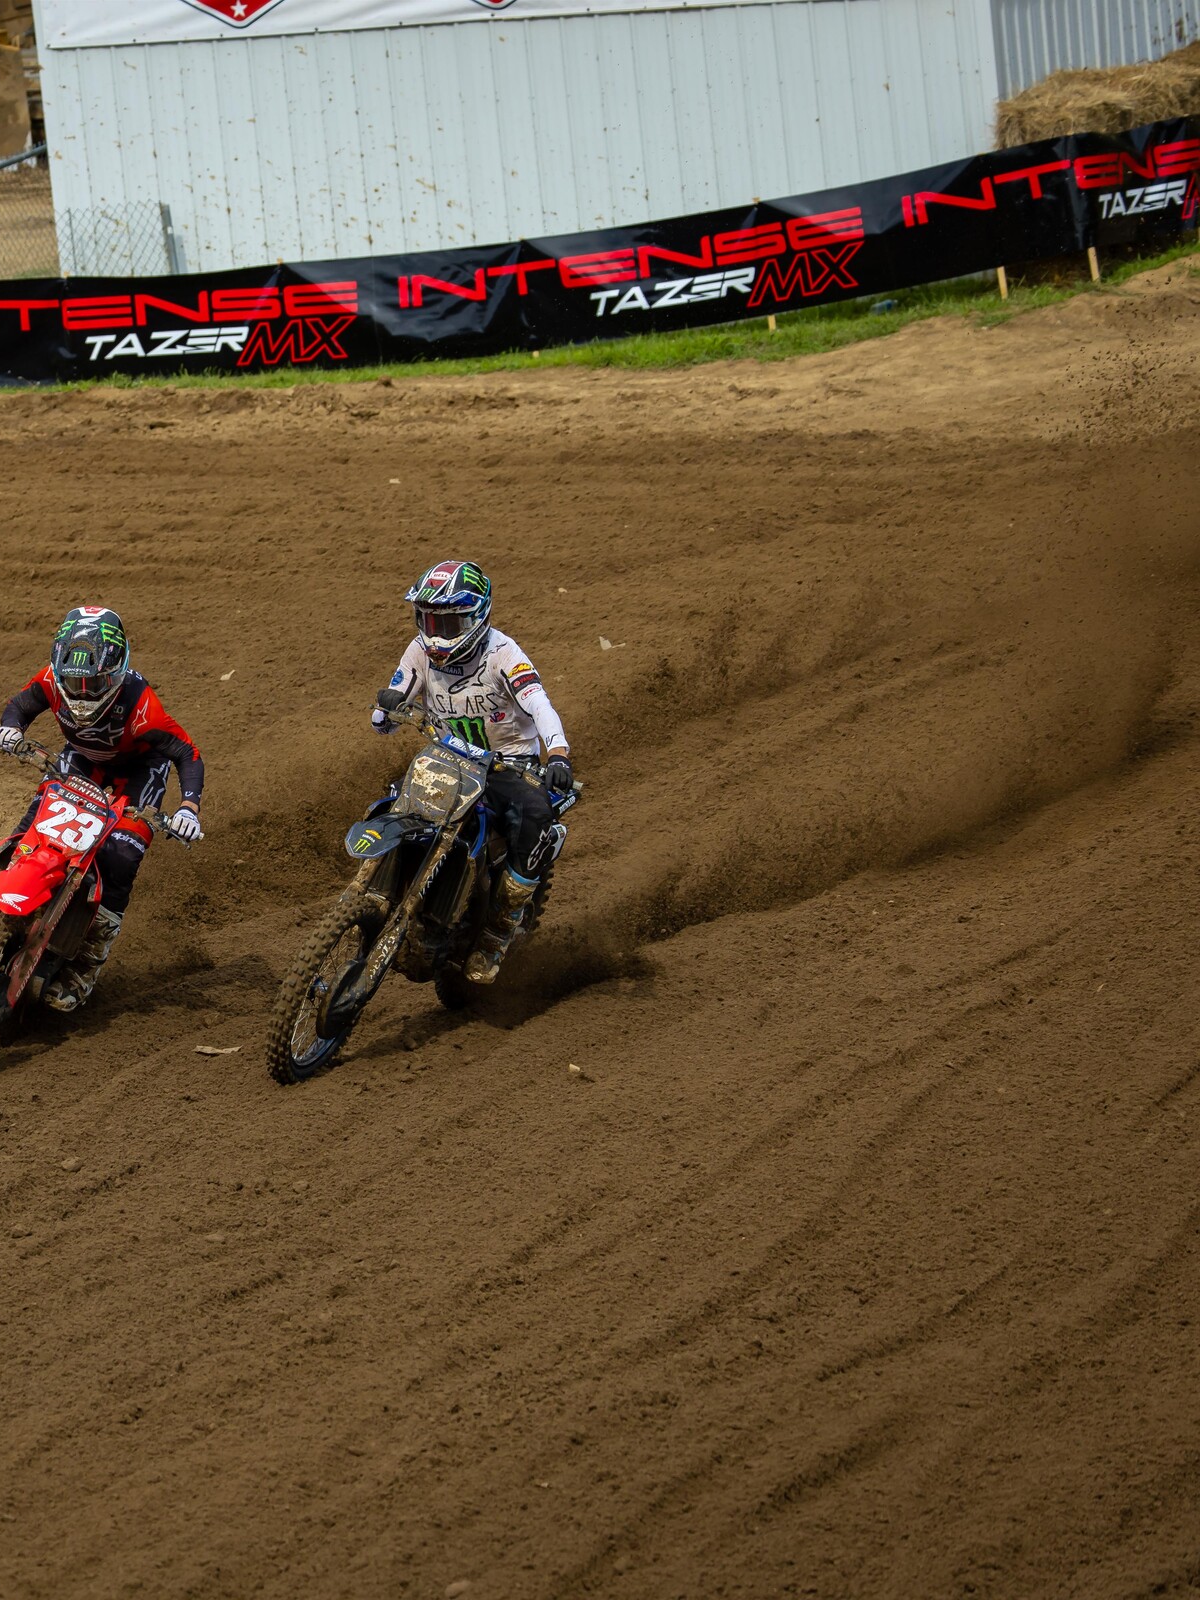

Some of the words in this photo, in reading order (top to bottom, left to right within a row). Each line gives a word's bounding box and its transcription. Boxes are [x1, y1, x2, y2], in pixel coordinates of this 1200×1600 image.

[902, 140, 1200, 227] INTENS
[1099, 180, 1186, 218] TAZER
[398, 207, 864, 308] INTENSE
[590, 267, 756, 316] TAZER
[748, 241, 864, 308] MX
[85, 327, 250, 361] TAZER
[237, 316, 358, 367] MX
[36, 800, 104, 852] 23
[86, 802, 97, 811] OIL
[0, 898, 23, 913] HONDA
